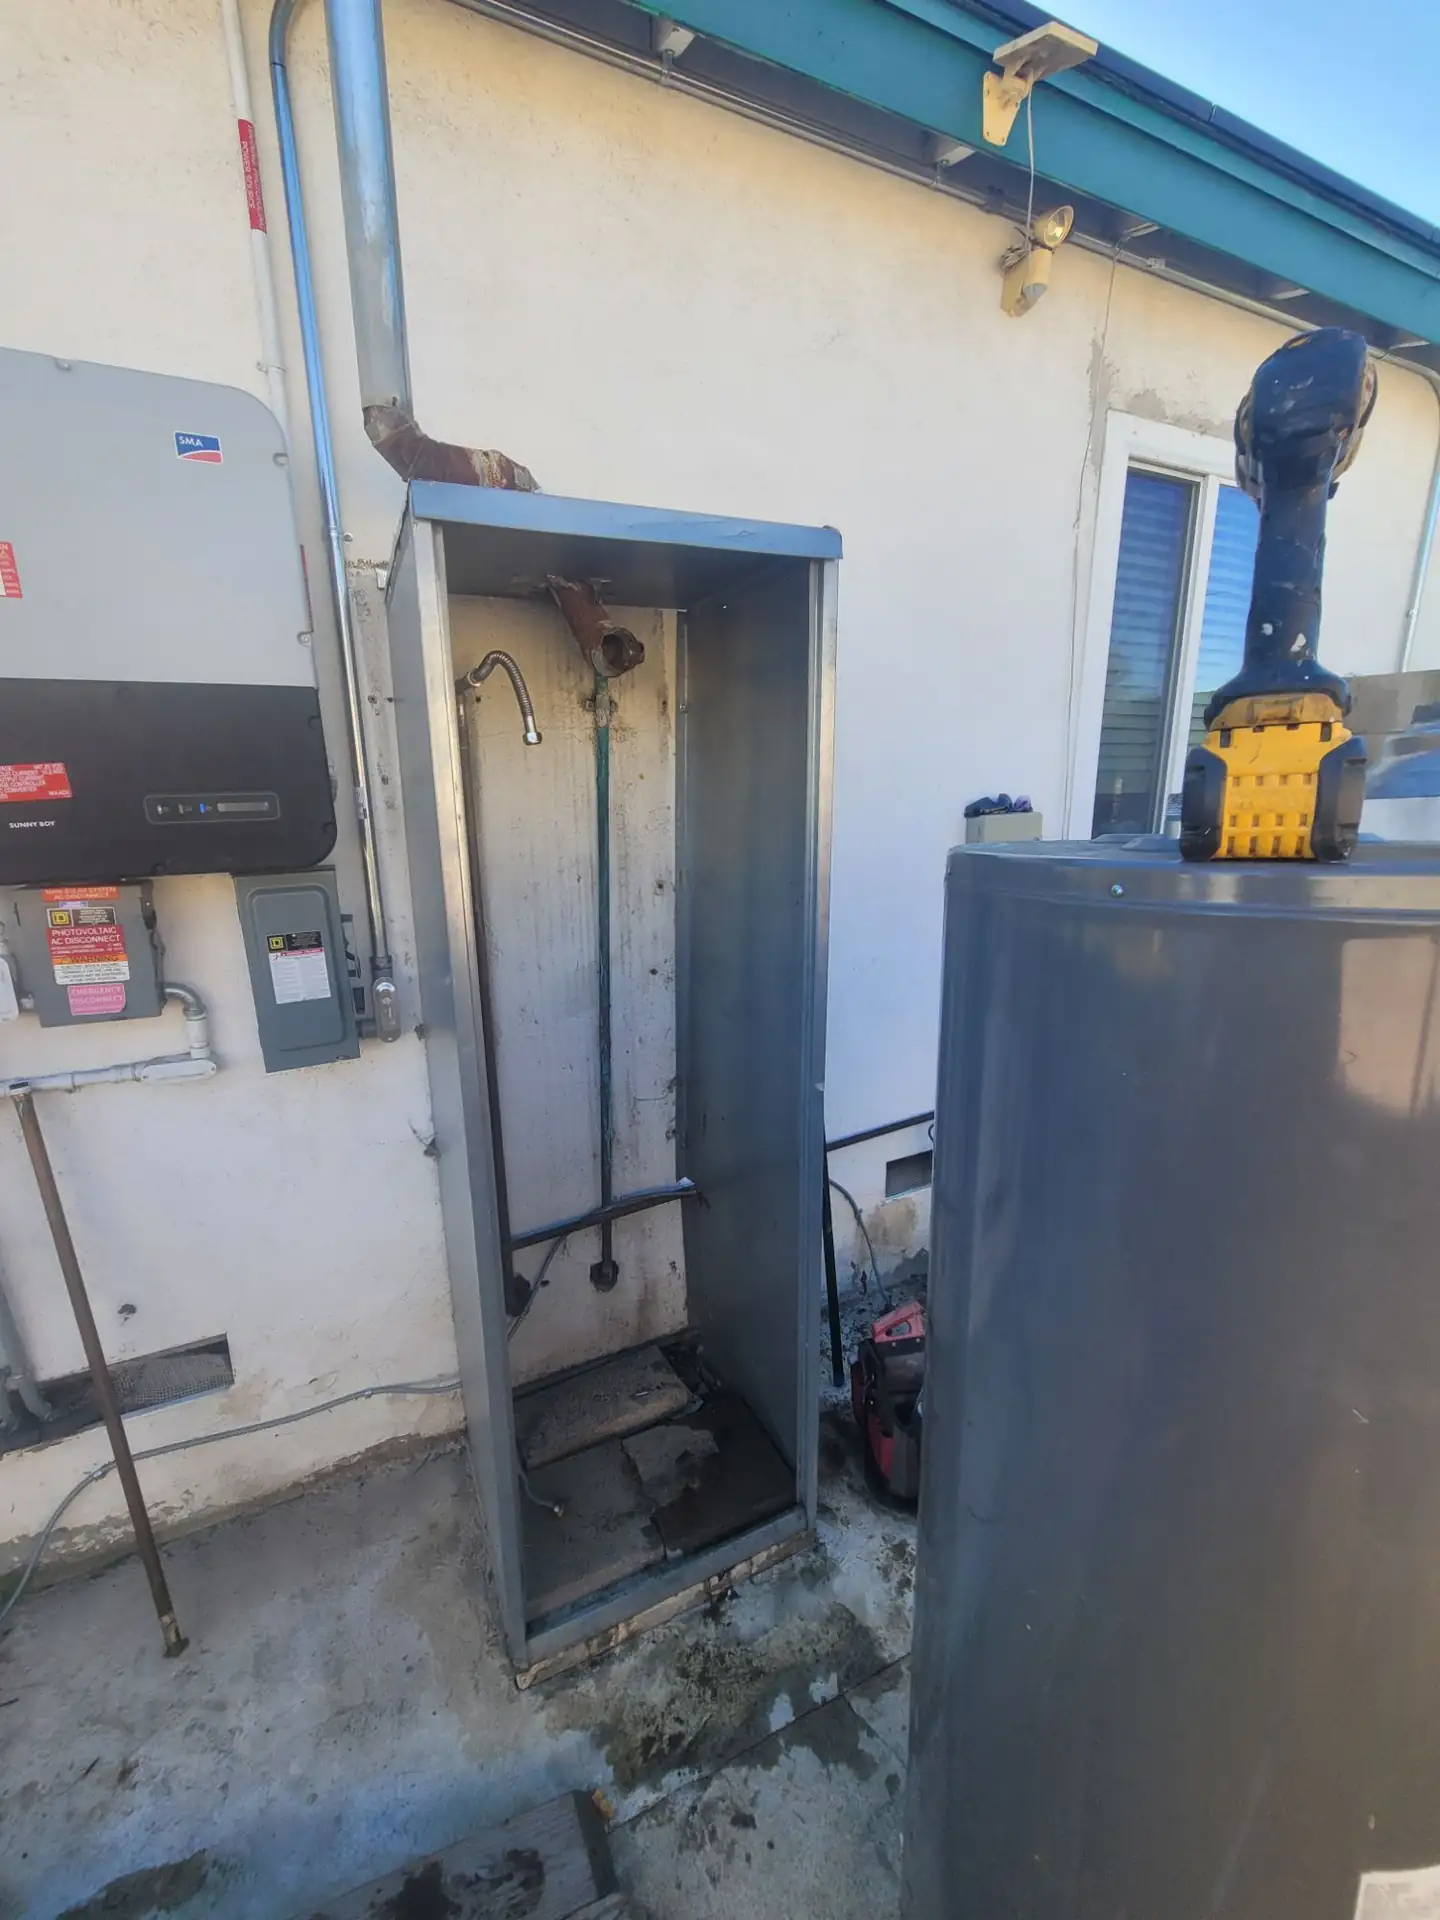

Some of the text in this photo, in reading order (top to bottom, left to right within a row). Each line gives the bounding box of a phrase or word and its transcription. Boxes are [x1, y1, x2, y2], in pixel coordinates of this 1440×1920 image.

[241, 140, 251, 173] POWER
[246, 174, 256, 209] SOURCE
[178, 435, 204, 448] SMA
[8, 821, 38, 829] SUNNY
[51, 926, 117, 937] PHOTOVOLTAIC
[51, 934, 121, 946] AC DISCONNECT
[69, 955, 119, 964] WARNING
